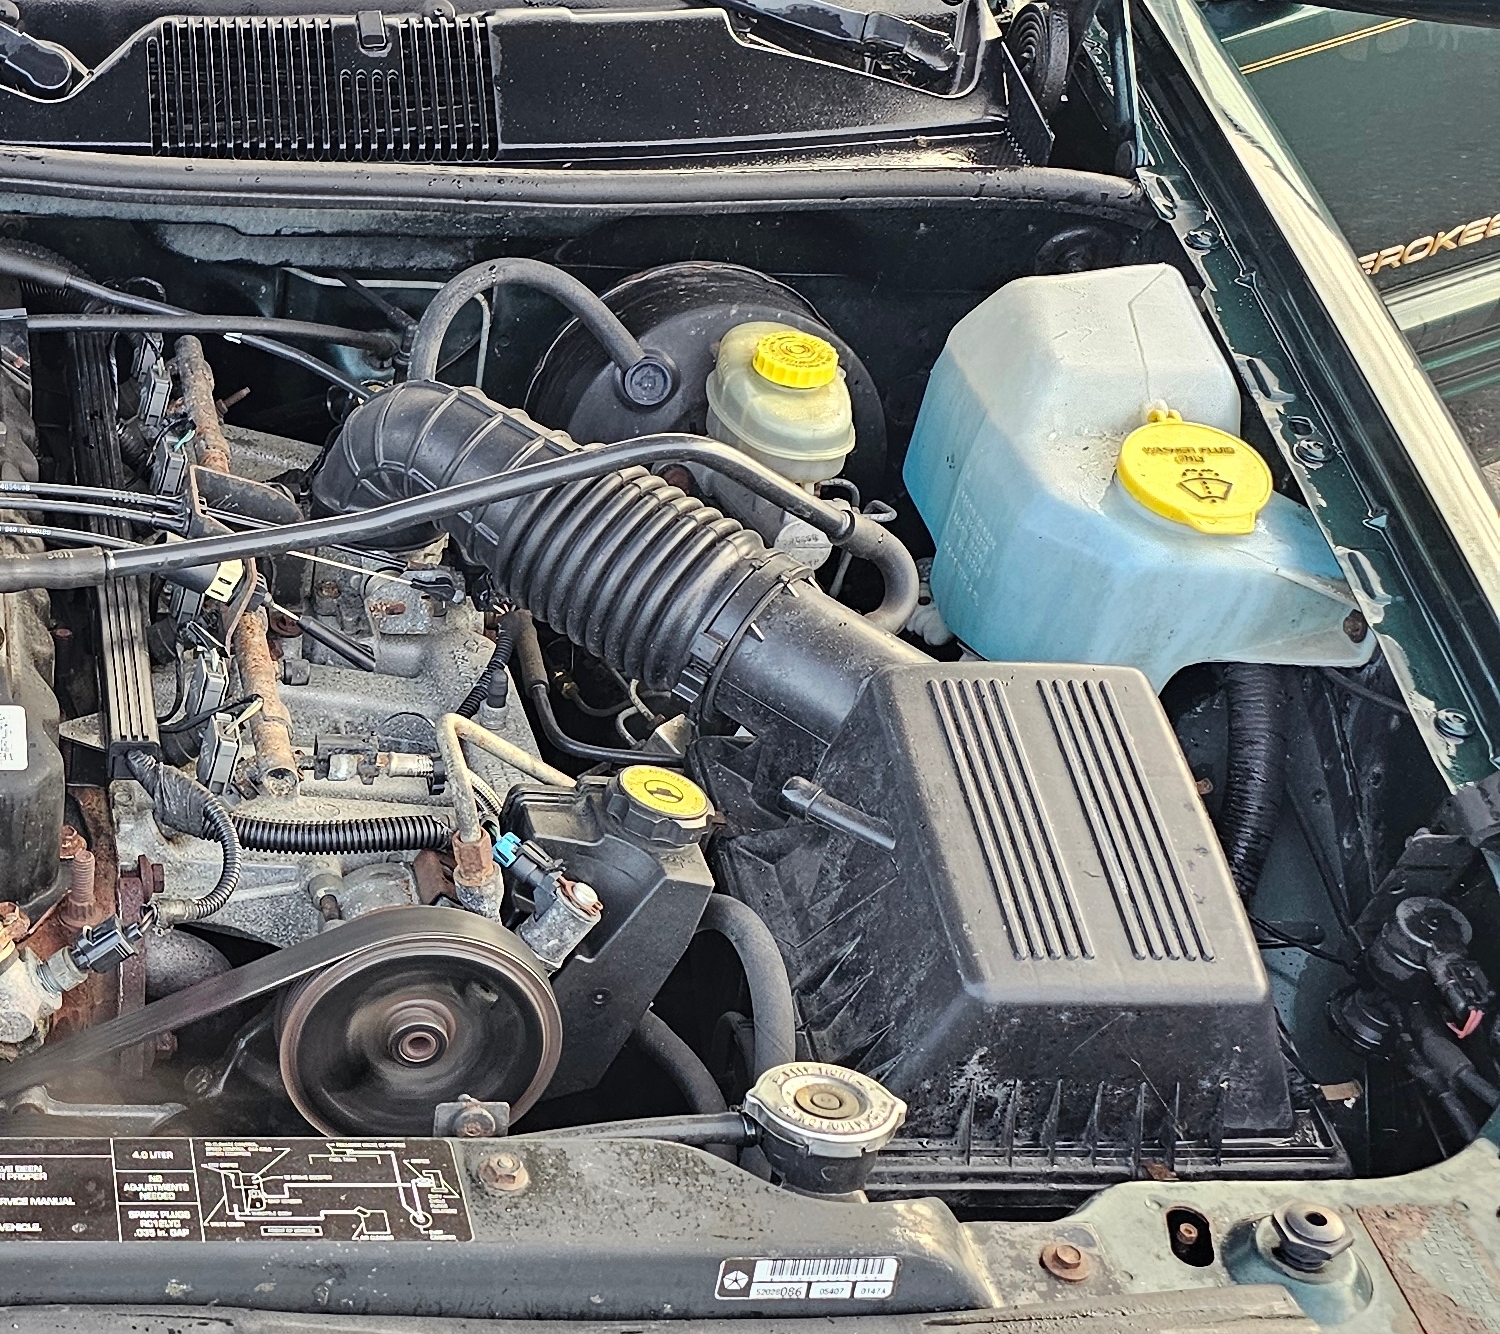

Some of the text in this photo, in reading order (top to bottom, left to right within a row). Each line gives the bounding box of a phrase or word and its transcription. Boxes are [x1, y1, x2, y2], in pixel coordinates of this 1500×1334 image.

[1142, 447, 1196, 455] WASHER
[132, 1151, 173, 1159] 4.0 LITER
[124, 1184, 190, 1192] ADJUSTMENTS
[139, 1192, 175, 1200] NEEDED
[128, 1211, 191, 1219] SPARK PLUGS
[170, 1229, 189, 1237] GAP
